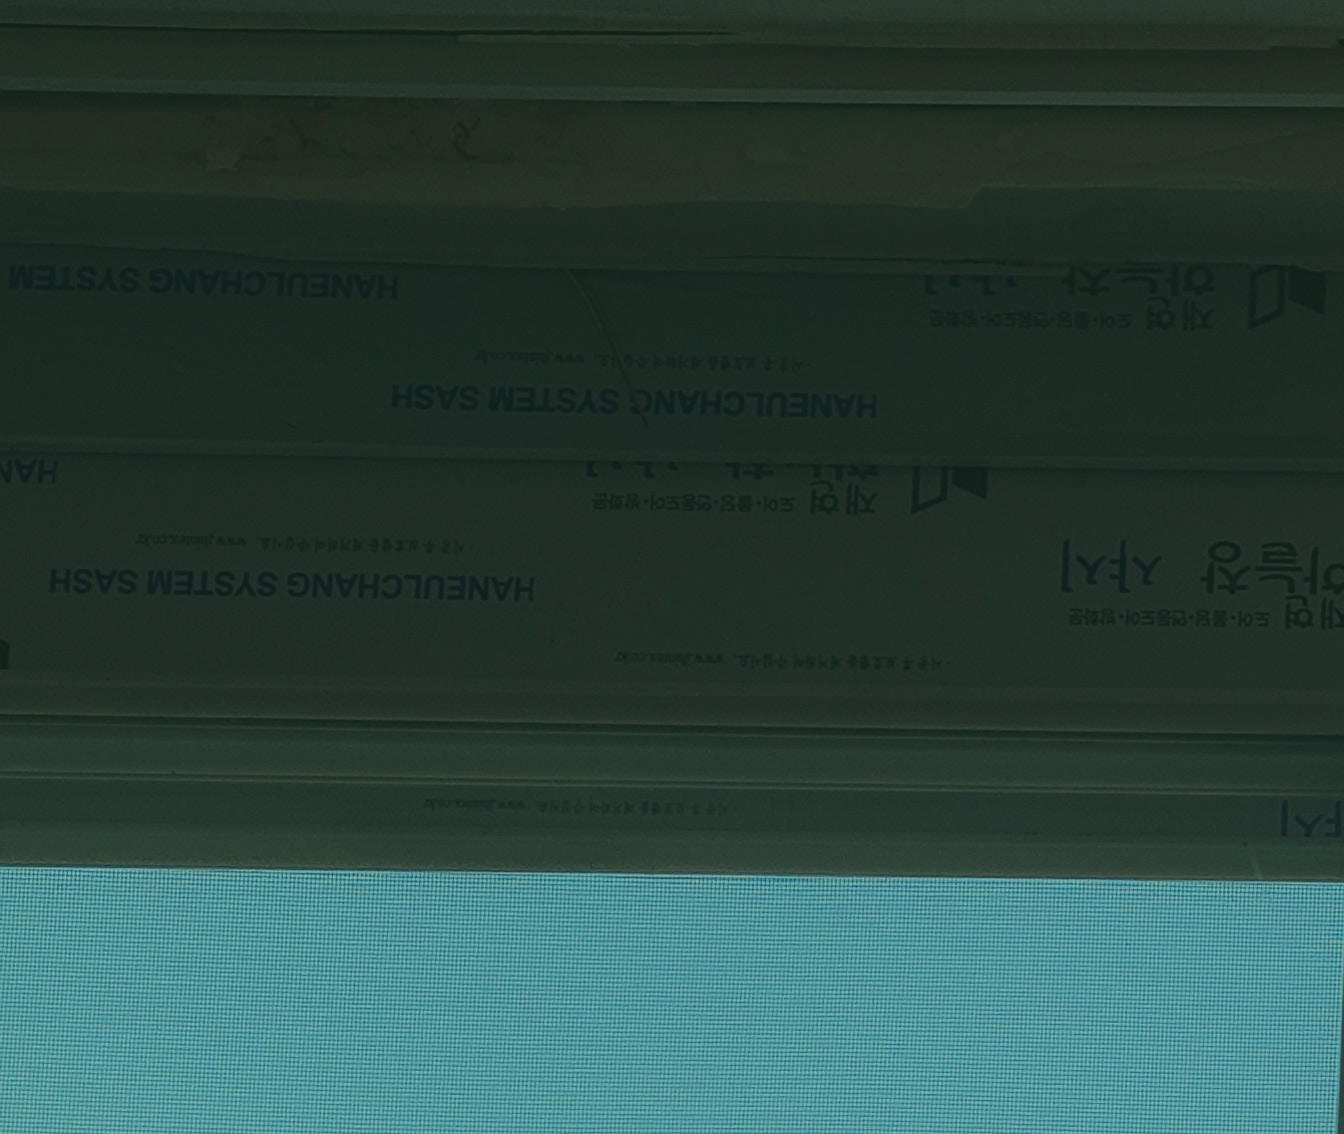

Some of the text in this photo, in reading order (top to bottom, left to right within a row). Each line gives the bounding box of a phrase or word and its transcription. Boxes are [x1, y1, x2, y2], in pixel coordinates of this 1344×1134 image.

[8, 263, 399, 300] HANEULCHANG SYSTEM
[1146, 296, 1215, 331] 재현
[391, 382, 877, 419] HANEULCHANG SYSTEM SASH
[809, 479, 879, 515] 재현
[1060, 538, 1162, 593] 샤시
[48, 567, 535, 602] HANEULCHANG SYSTEM SASH
